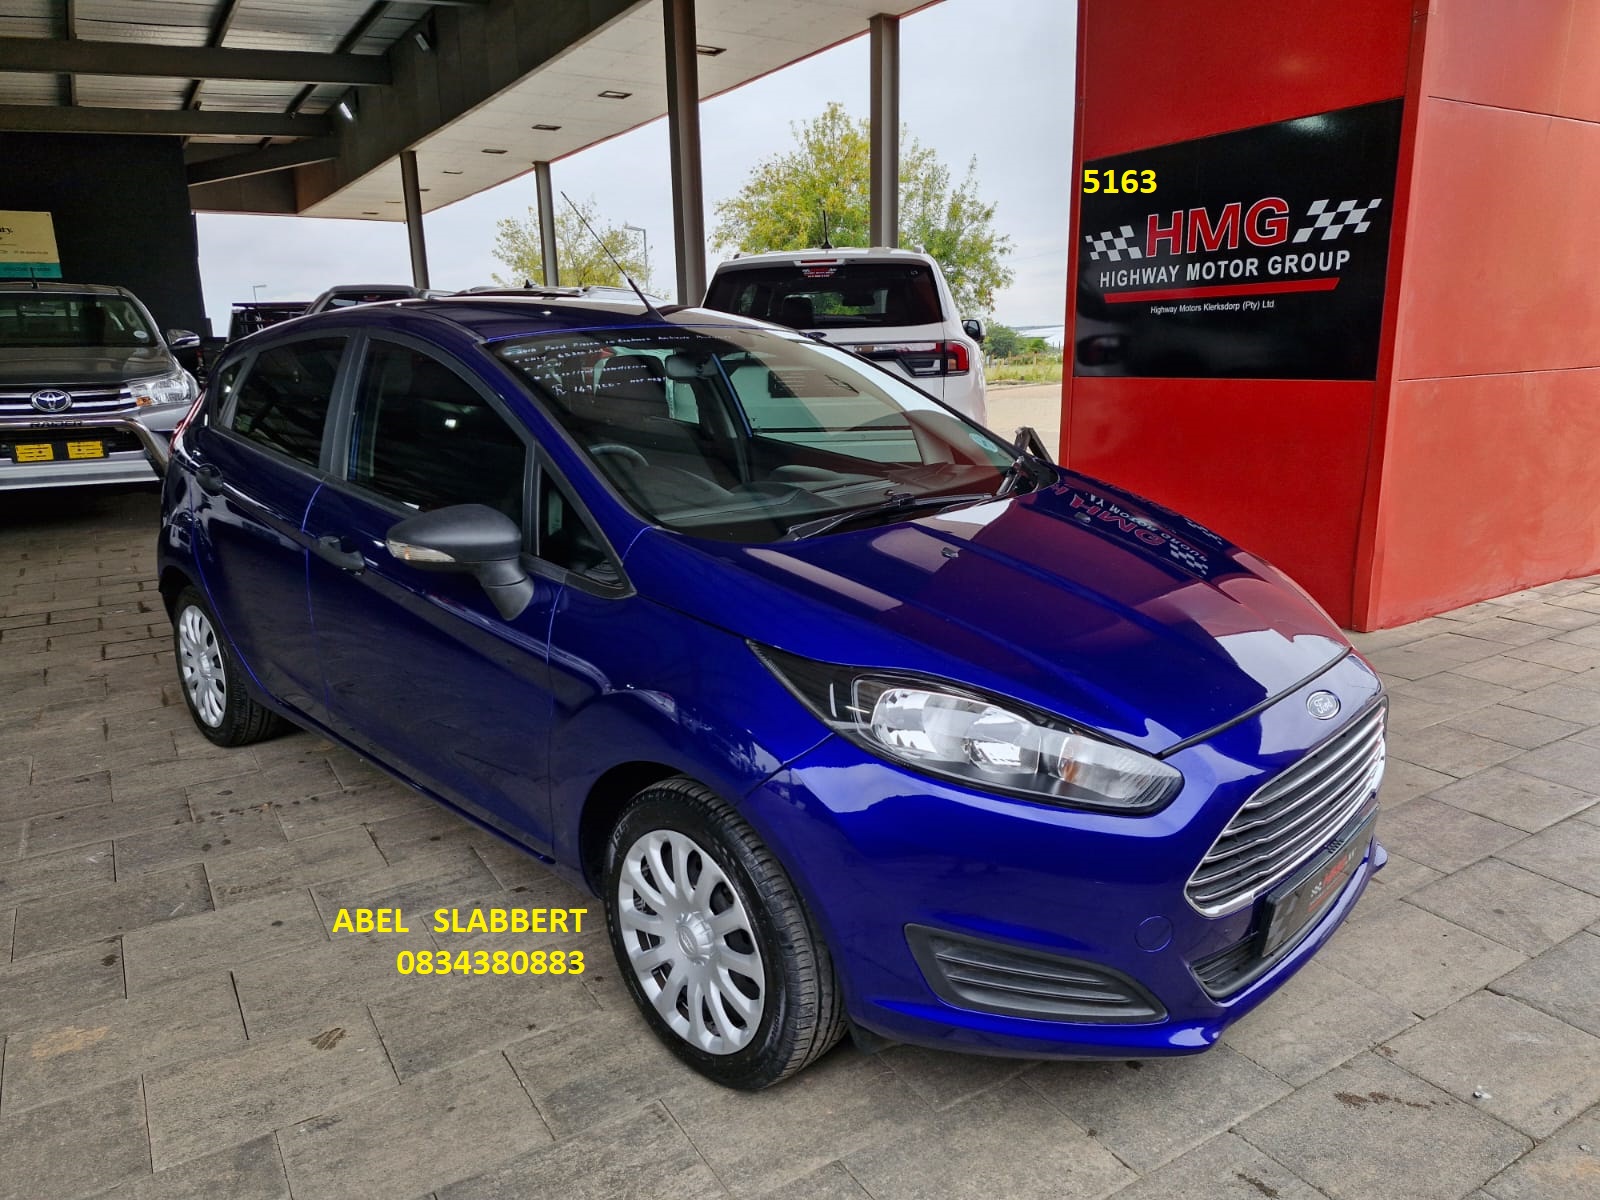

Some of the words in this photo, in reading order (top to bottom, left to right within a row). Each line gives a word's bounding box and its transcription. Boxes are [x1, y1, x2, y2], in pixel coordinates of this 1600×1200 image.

[1145, 197, 1290, 258] HMG
[1099, 264, 1181, 288] HIGHWAY
[1186, 257, 1259, 282] MOTOR
[1267, 250, 1352, 275] GROUP
[1150, 306, 1178, 315] Highway
[1179, 304, 1202, 313] Motors
[1203, 302, 1241, 311] Klerksdorp
[1242, 300, 1260, 311] (Pty)
[1262, 299, 1275, 309] Ltd
